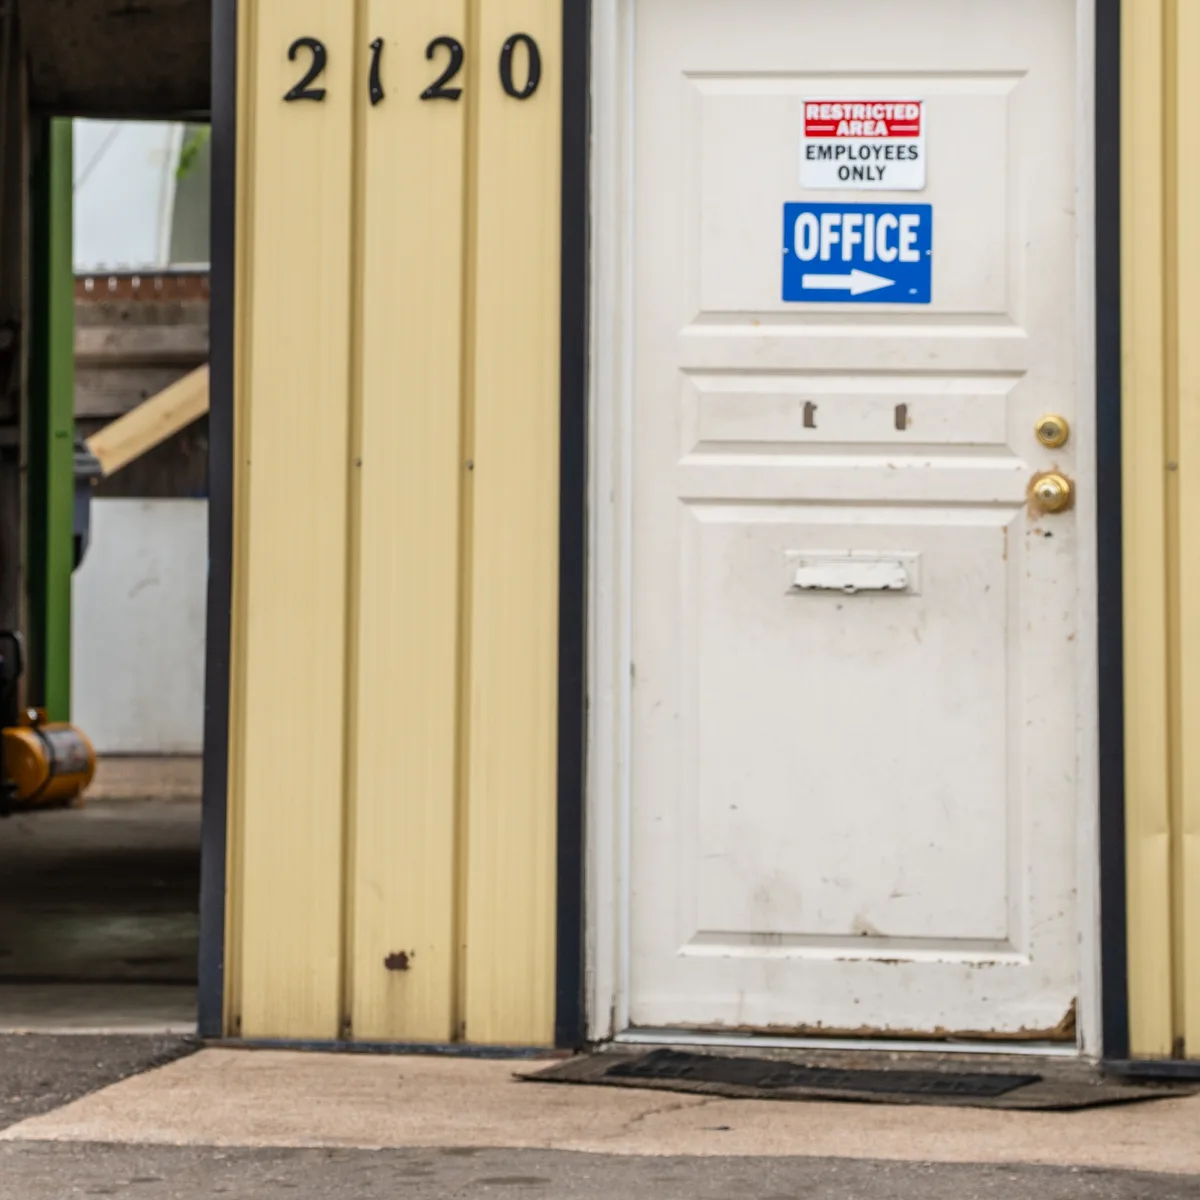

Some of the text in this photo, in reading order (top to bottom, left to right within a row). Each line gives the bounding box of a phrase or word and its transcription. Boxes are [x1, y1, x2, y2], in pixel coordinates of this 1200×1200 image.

[283, 32, 542, 107] 2120
[806, 103, 919, 121] RESTRICTED
[835, 120, 889, 137] AREA
[805, 144, 919, 161] EMPLOYEES
[837, 165, 887, 182] ONLY
[793, 211, 921, 263] OFFICE
